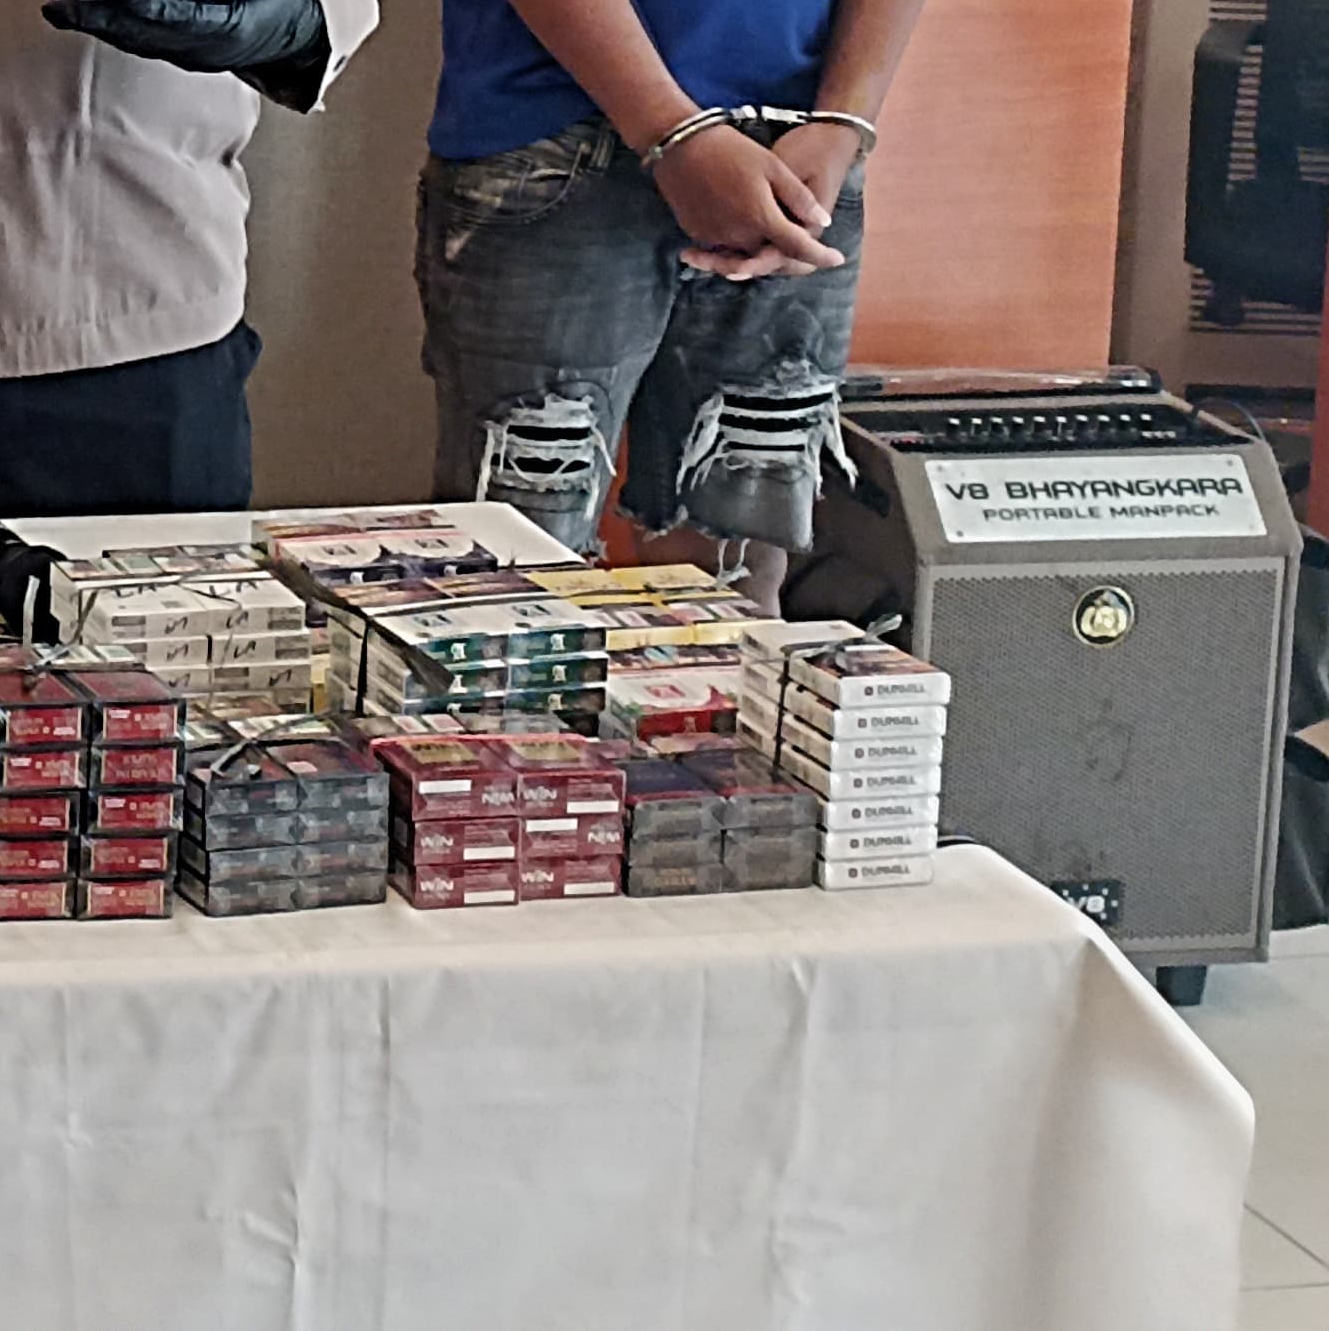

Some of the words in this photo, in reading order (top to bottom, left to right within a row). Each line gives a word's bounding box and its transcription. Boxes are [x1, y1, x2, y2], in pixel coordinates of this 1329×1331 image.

[945, 483, 990, 500] V8
[1005, 478, 1243, 501] BHAYANGKARA
[983, 506, 1102, 521] PORTABLE
[1110, 504, 1220, 519] MANPACK
